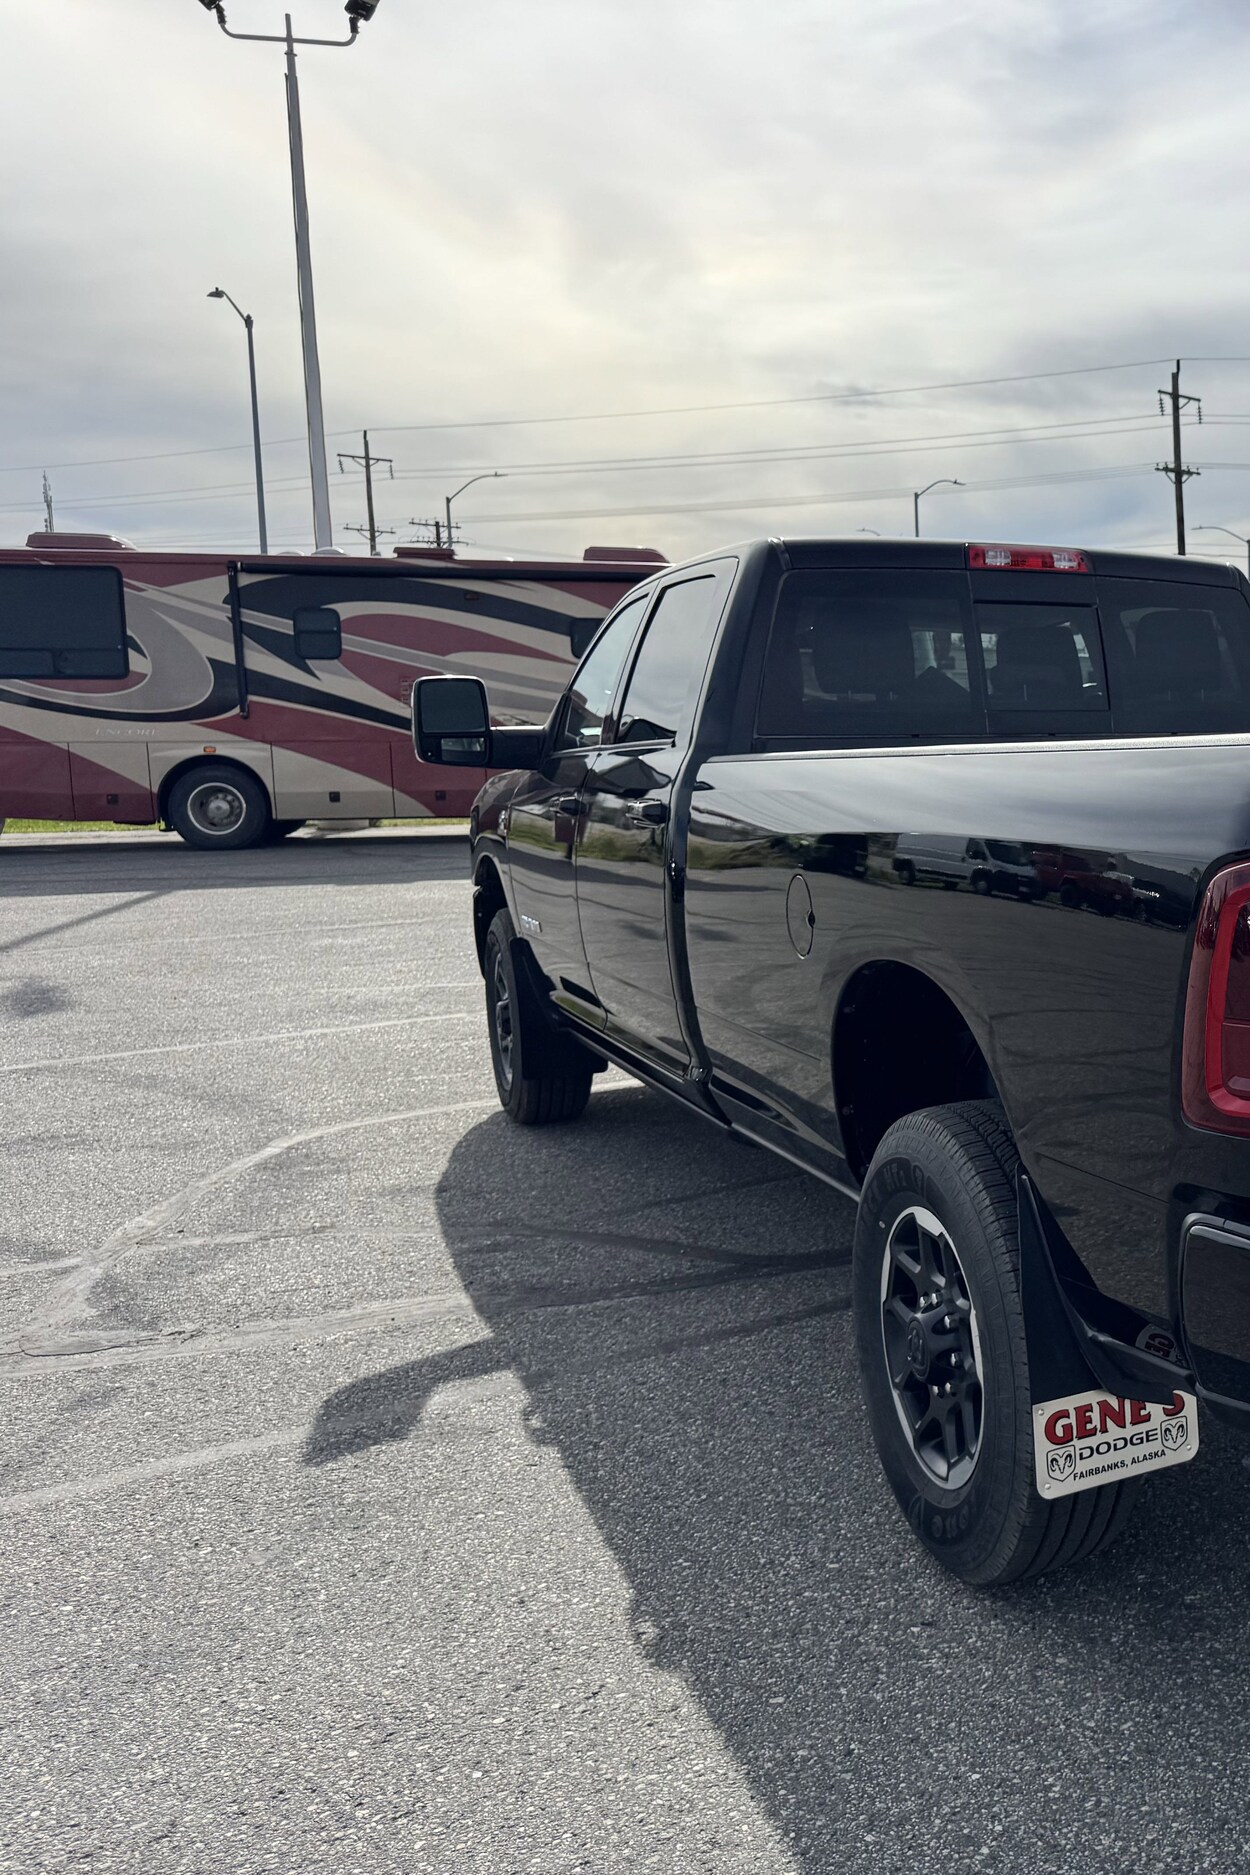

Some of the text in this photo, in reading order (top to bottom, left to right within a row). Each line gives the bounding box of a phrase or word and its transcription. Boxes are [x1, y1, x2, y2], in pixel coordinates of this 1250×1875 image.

[1044, 1393, 1186, 1446] GENE
[1079, 1427, 1159, 1461] DODGE
[1073, 1449, 1166, 1481] FAIRBANKS, ALASKA
